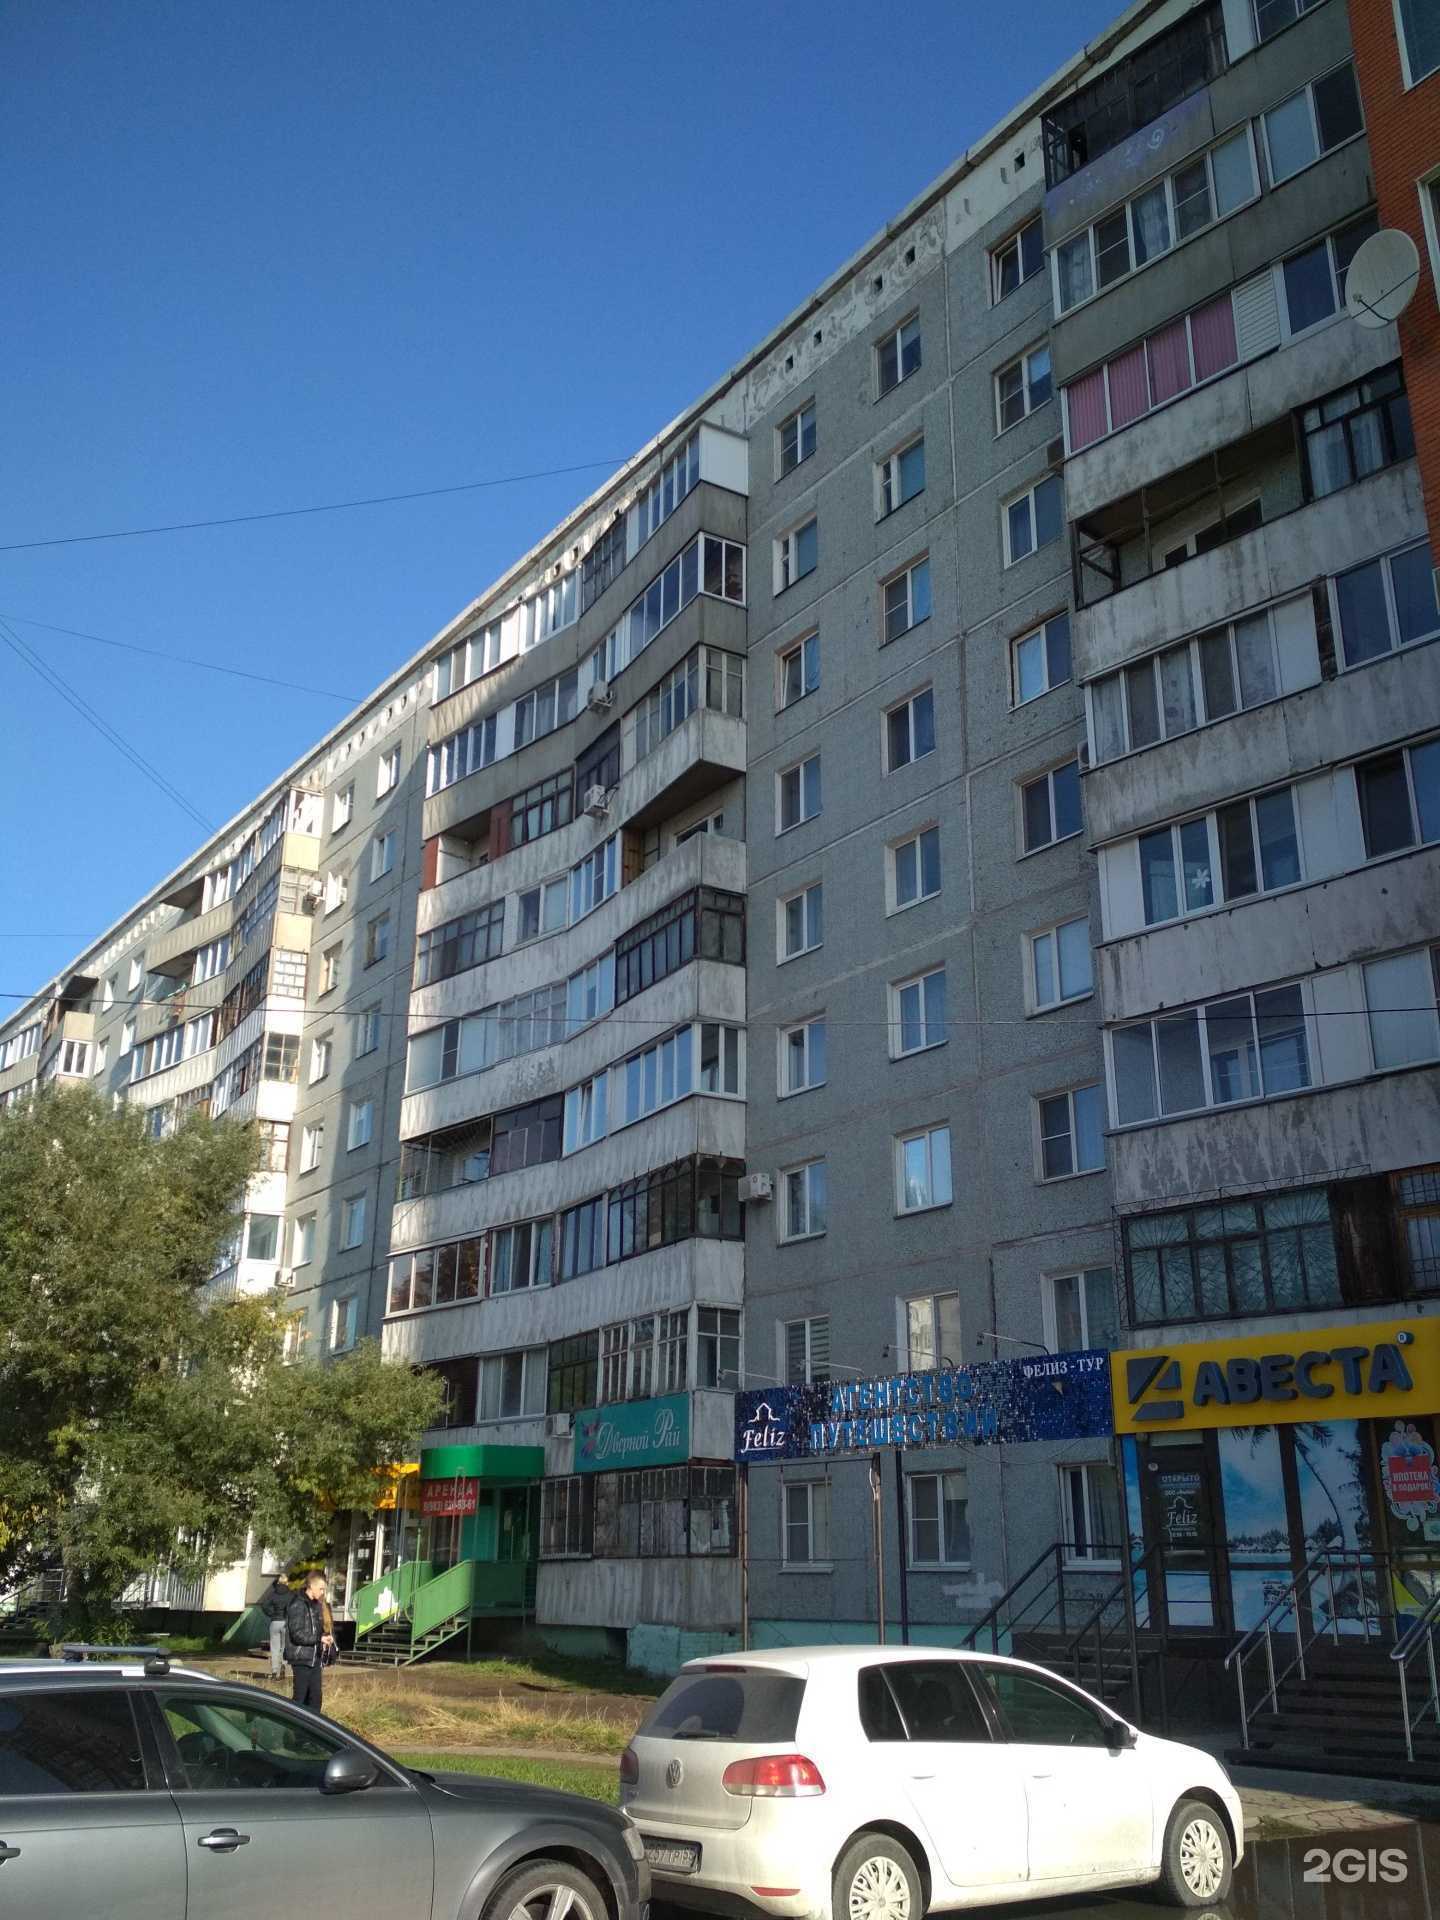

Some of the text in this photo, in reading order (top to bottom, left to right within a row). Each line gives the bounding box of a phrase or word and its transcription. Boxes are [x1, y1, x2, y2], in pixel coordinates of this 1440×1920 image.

[831, 1373, 972, 1412] АГЕНТСТВО
[1193, 1344, 1414, 1406] АВЕСТА
[652, 1408, 681, 1449] Рай
[740, 1427, 785, 1453] Feliz
